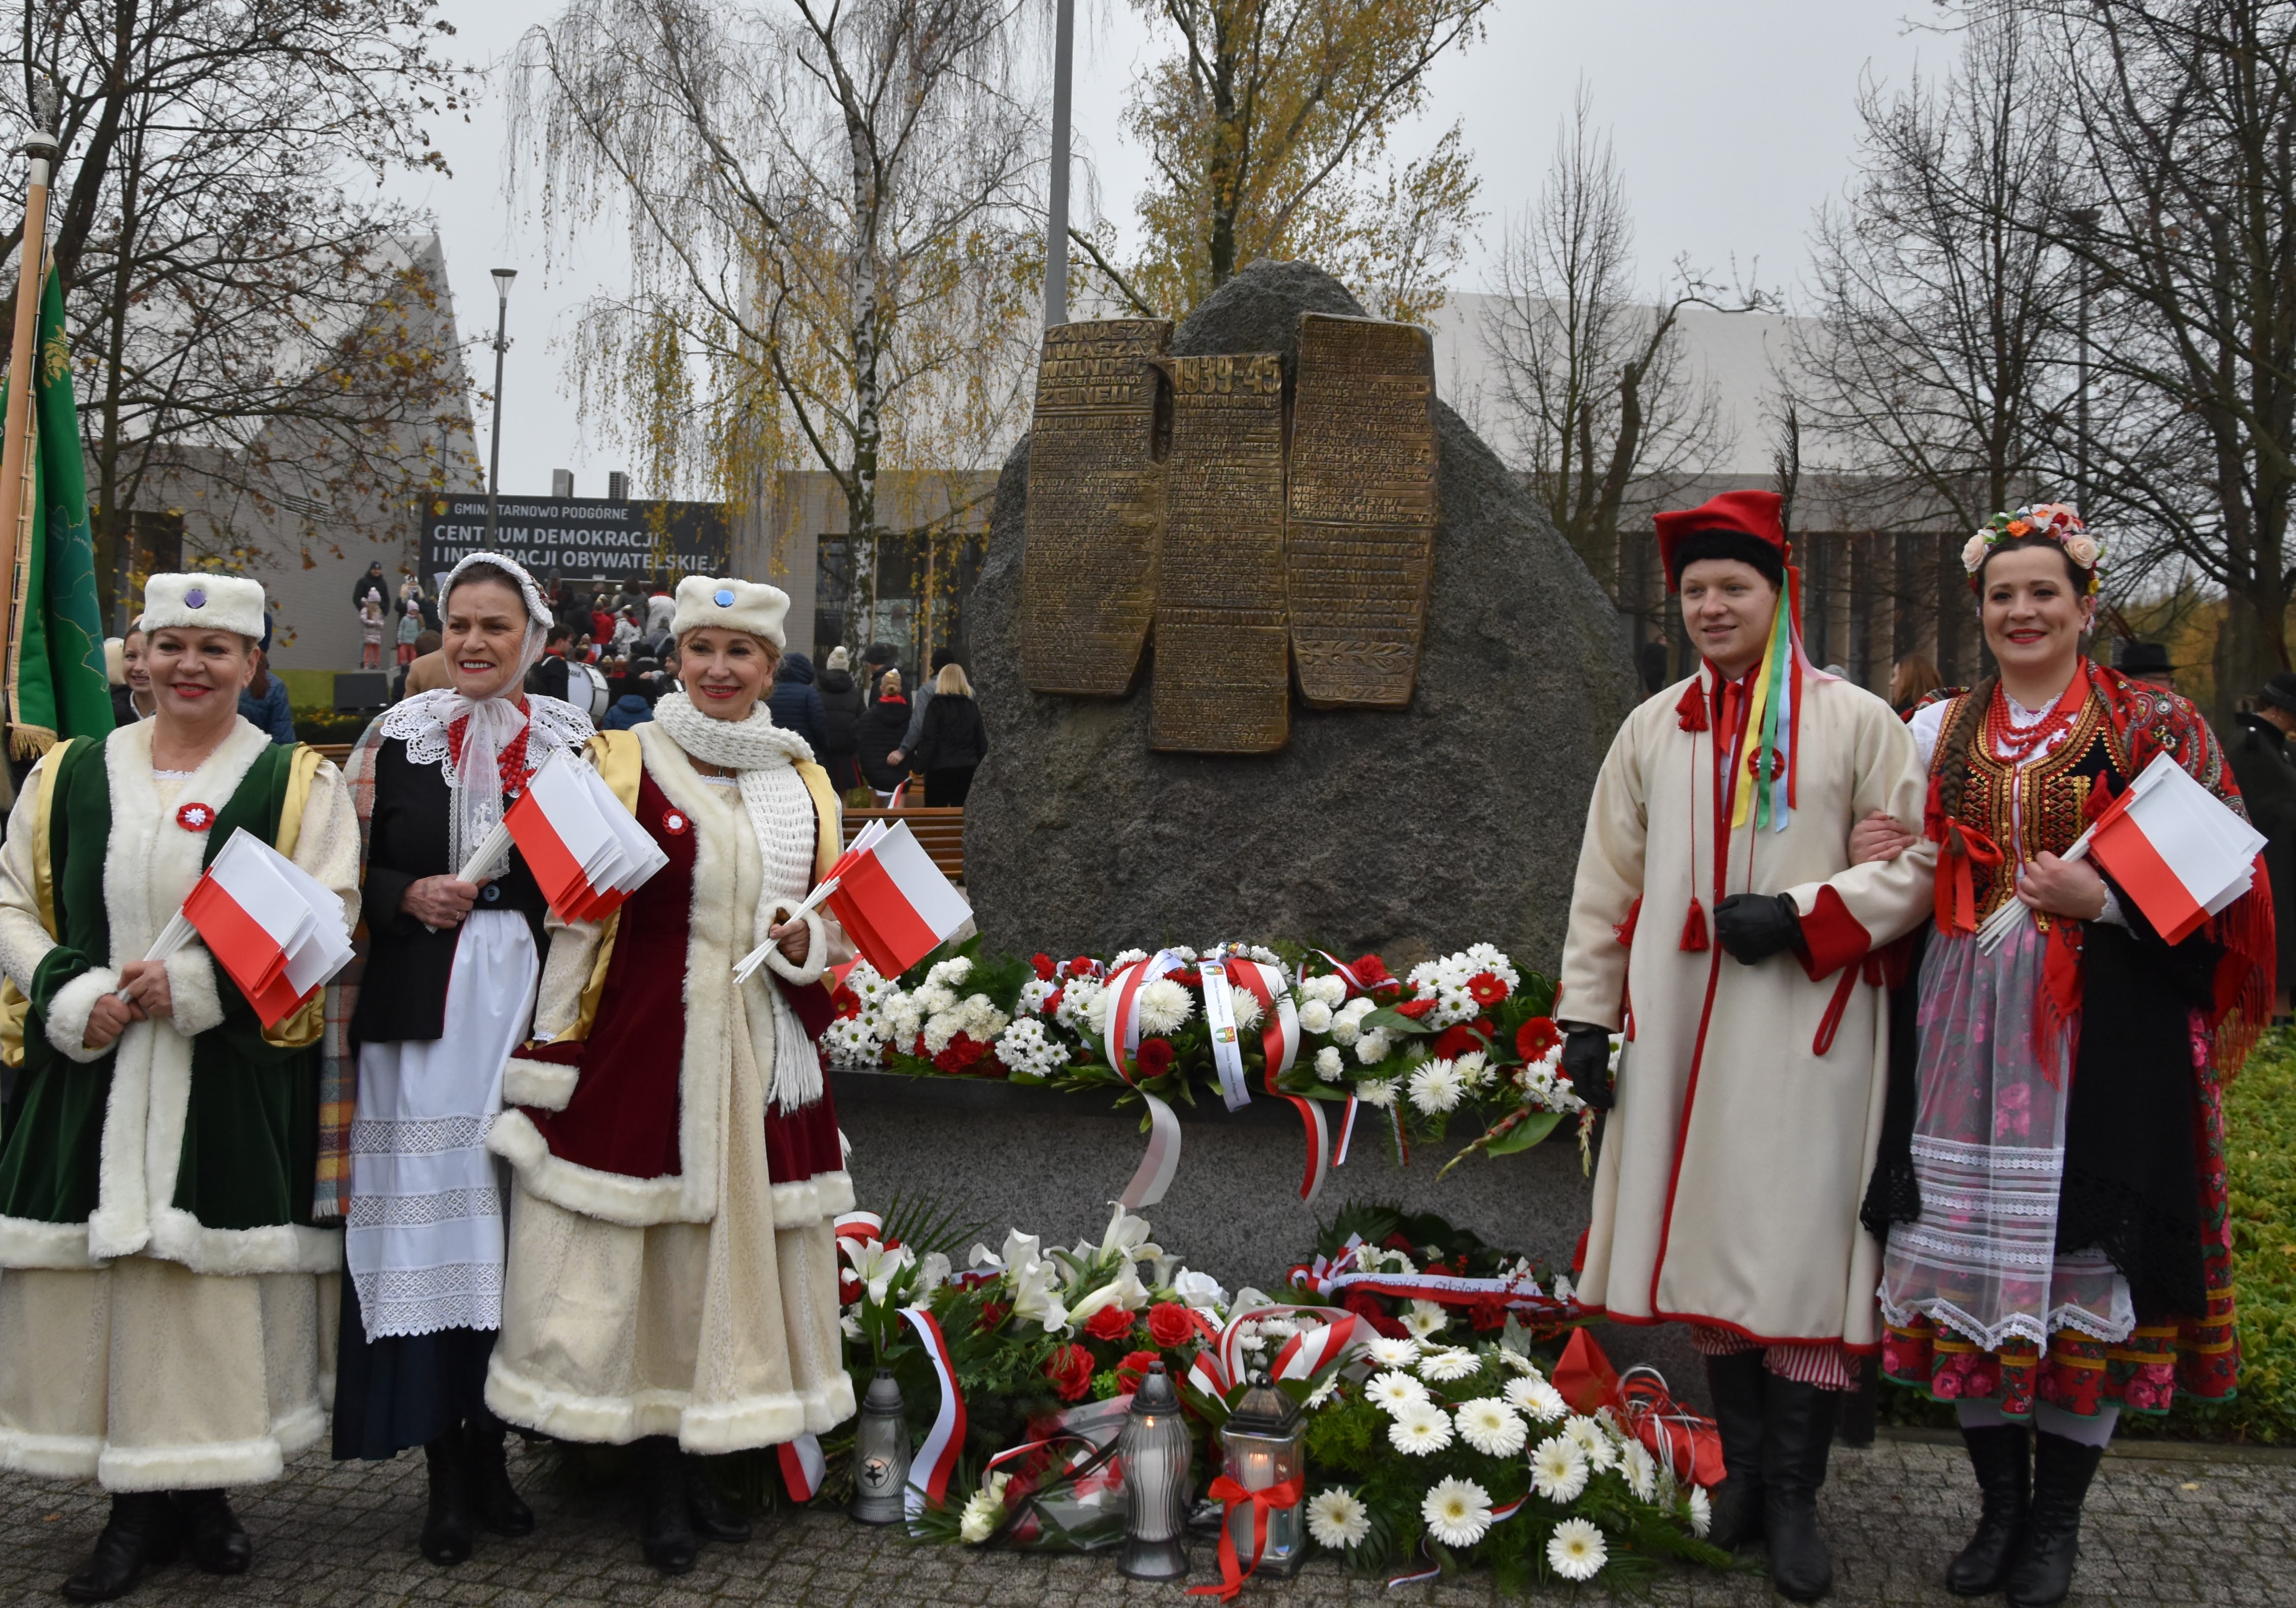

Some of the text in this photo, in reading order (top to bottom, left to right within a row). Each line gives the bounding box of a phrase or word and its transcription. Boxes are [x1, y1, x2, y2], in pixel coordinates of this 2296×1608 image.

[1170, 354, 1282, 394] 1939-45
[1342, 373, 1365, 381] JAN
[1048, 377, 1087, 386] NASZEJ
[1089, 375, 1143, 385] GROMADY
[1371, 382, 1418, 391] ANTONI
[1191, 395, 1229, 408] RUCHU
[1378, 408, 1428, 416] JADWIGA
[1034, 418, 1050, 430] NA
[1054, 417, 1082, 430] POLU
[1296, 420, 1424, 432] PIOTROWSKI EDMUND
[1374, 431, 1398, 440] JAN
[1294, 445, 1423, 456] SKRZYPEK CZESŁAW
[1294, 453, 1422, 465] STAWSKI KAZIMIERZ
[1293, 461, 1404, 473] SZWEDEK STEFAN
[1292, 470, 1351, 479] SZWEDEK
[454, 503, 629, 520] GMIN TARNOWO PODGÓRNE
[1355, 505, 1396, 513] MARIA
[1358, 513, 1424, 522] STANISŁAW
[433, 524, 660, 547] CENTUM DEMOKRACJI
[433, 546, 439, 562] I
[562, 550, 720, 571] OBYWATELSKIEJ
[1305, 684, 1340, 697] ROK
